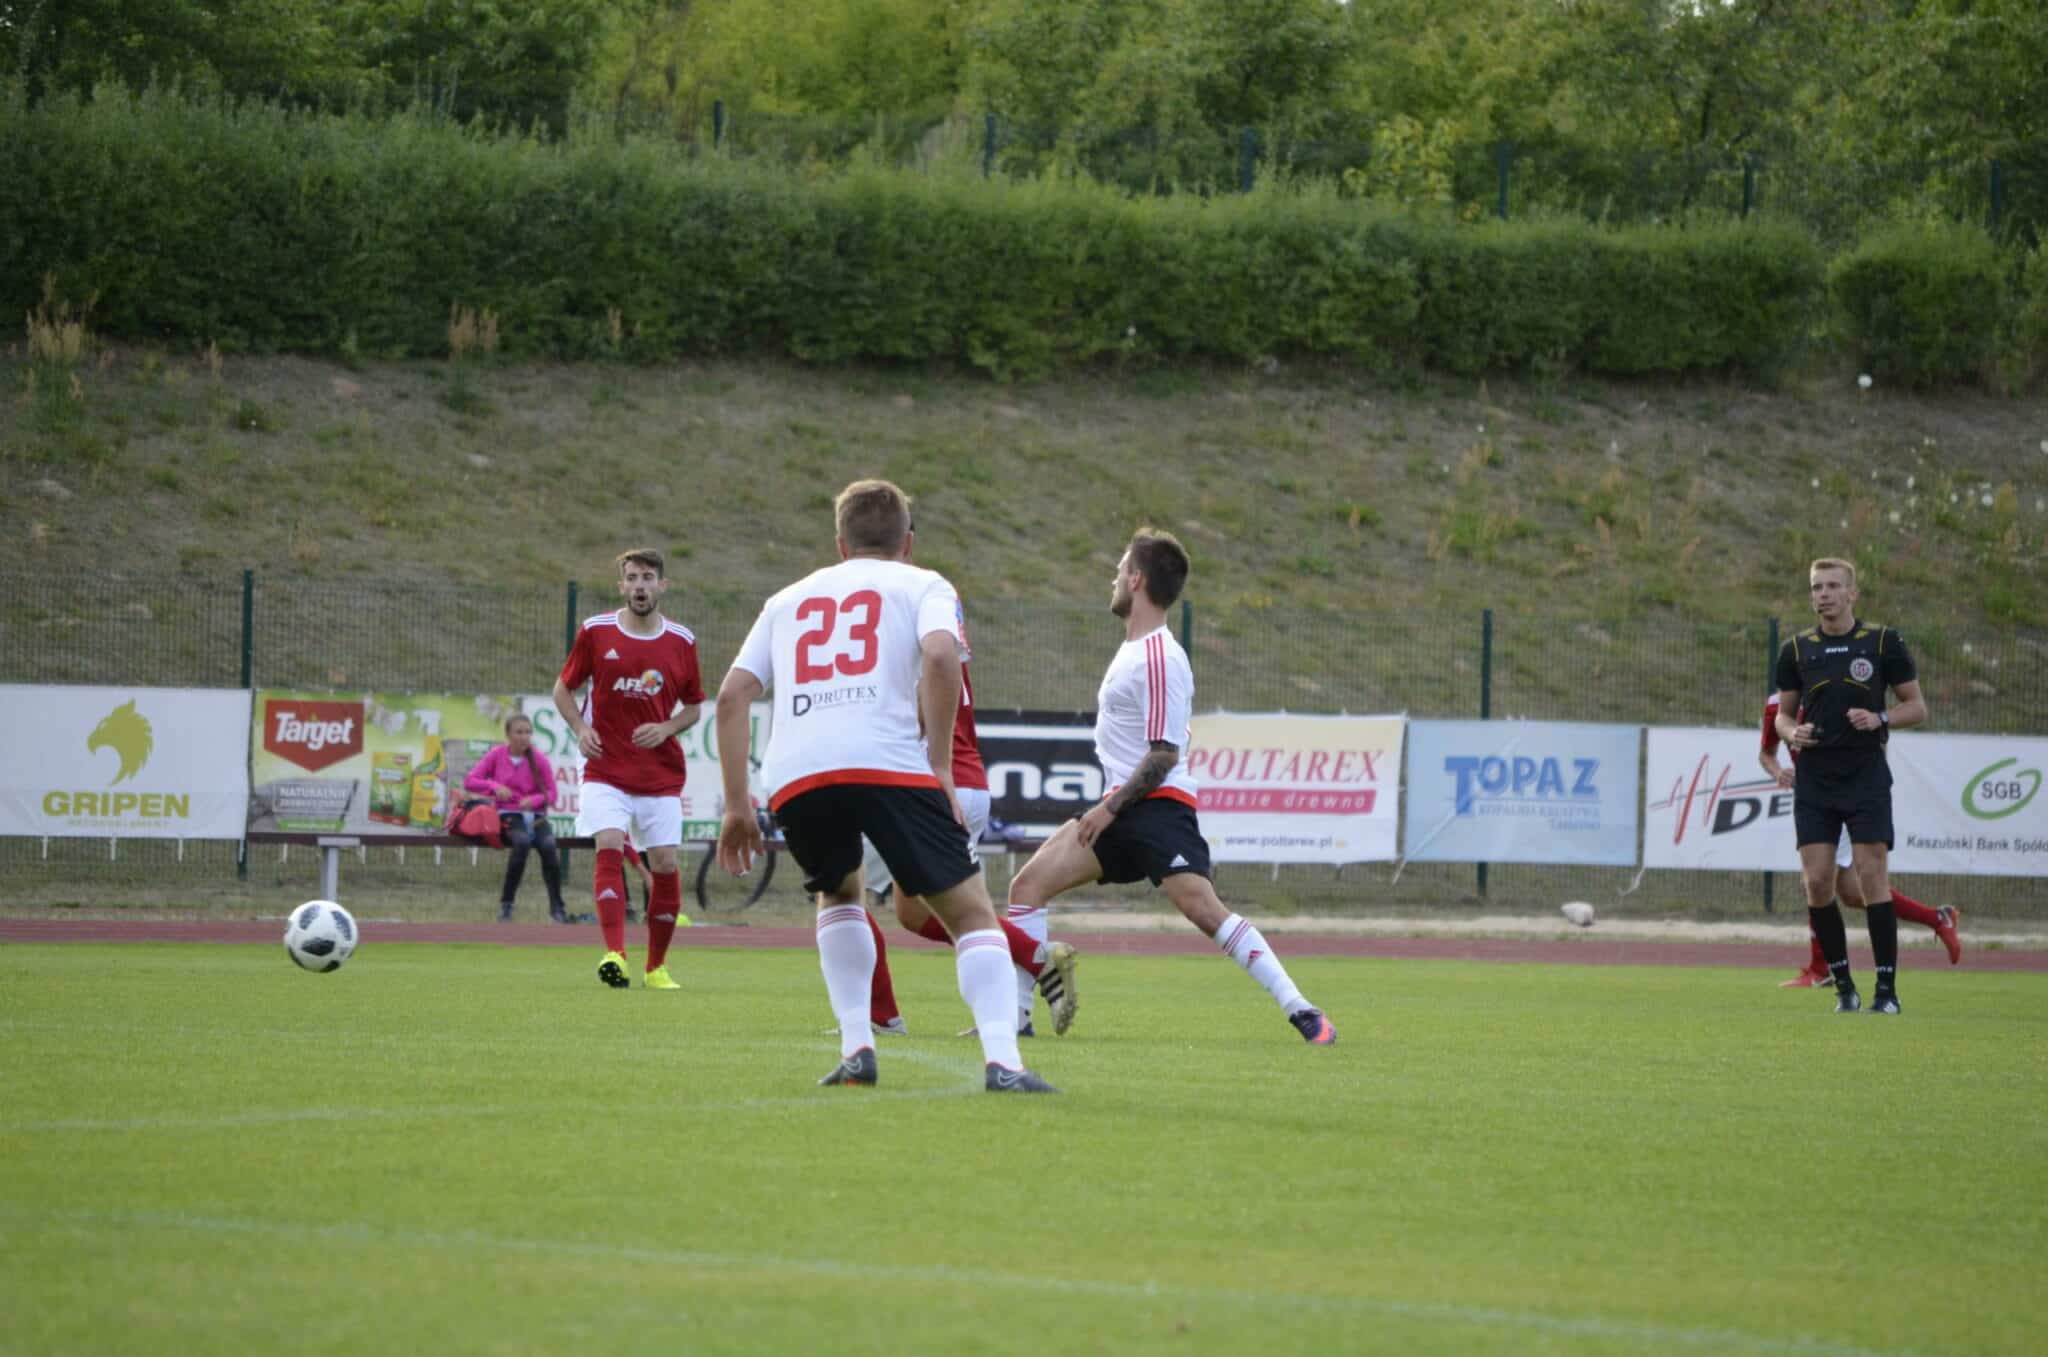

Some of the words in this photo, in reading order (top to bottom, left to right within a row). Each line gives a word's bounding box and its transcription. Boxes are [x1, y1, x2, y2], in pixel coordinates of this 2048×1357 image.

[795, 590, 882, 685] 23
[813, 686, 879, 706] DRUTEX
[275, 712, 354, 750] Target
[1187, 748, 1385, 783] POLTAREX
[1445, 756, 1600, 816] TOPAZ
[1981, 781, 2022, 800] SGB
[42, 791, 190, 818] GRIPEN
[1202, 791, 1272, 808] olskie
[1284, 793, 1366, 809] drewno
[1225, 834, 1333, 850] www.poltarex.pl
[1907, 835, 1973, 850] Kaszubski
[1976, 836, 2009, 851] Bank
